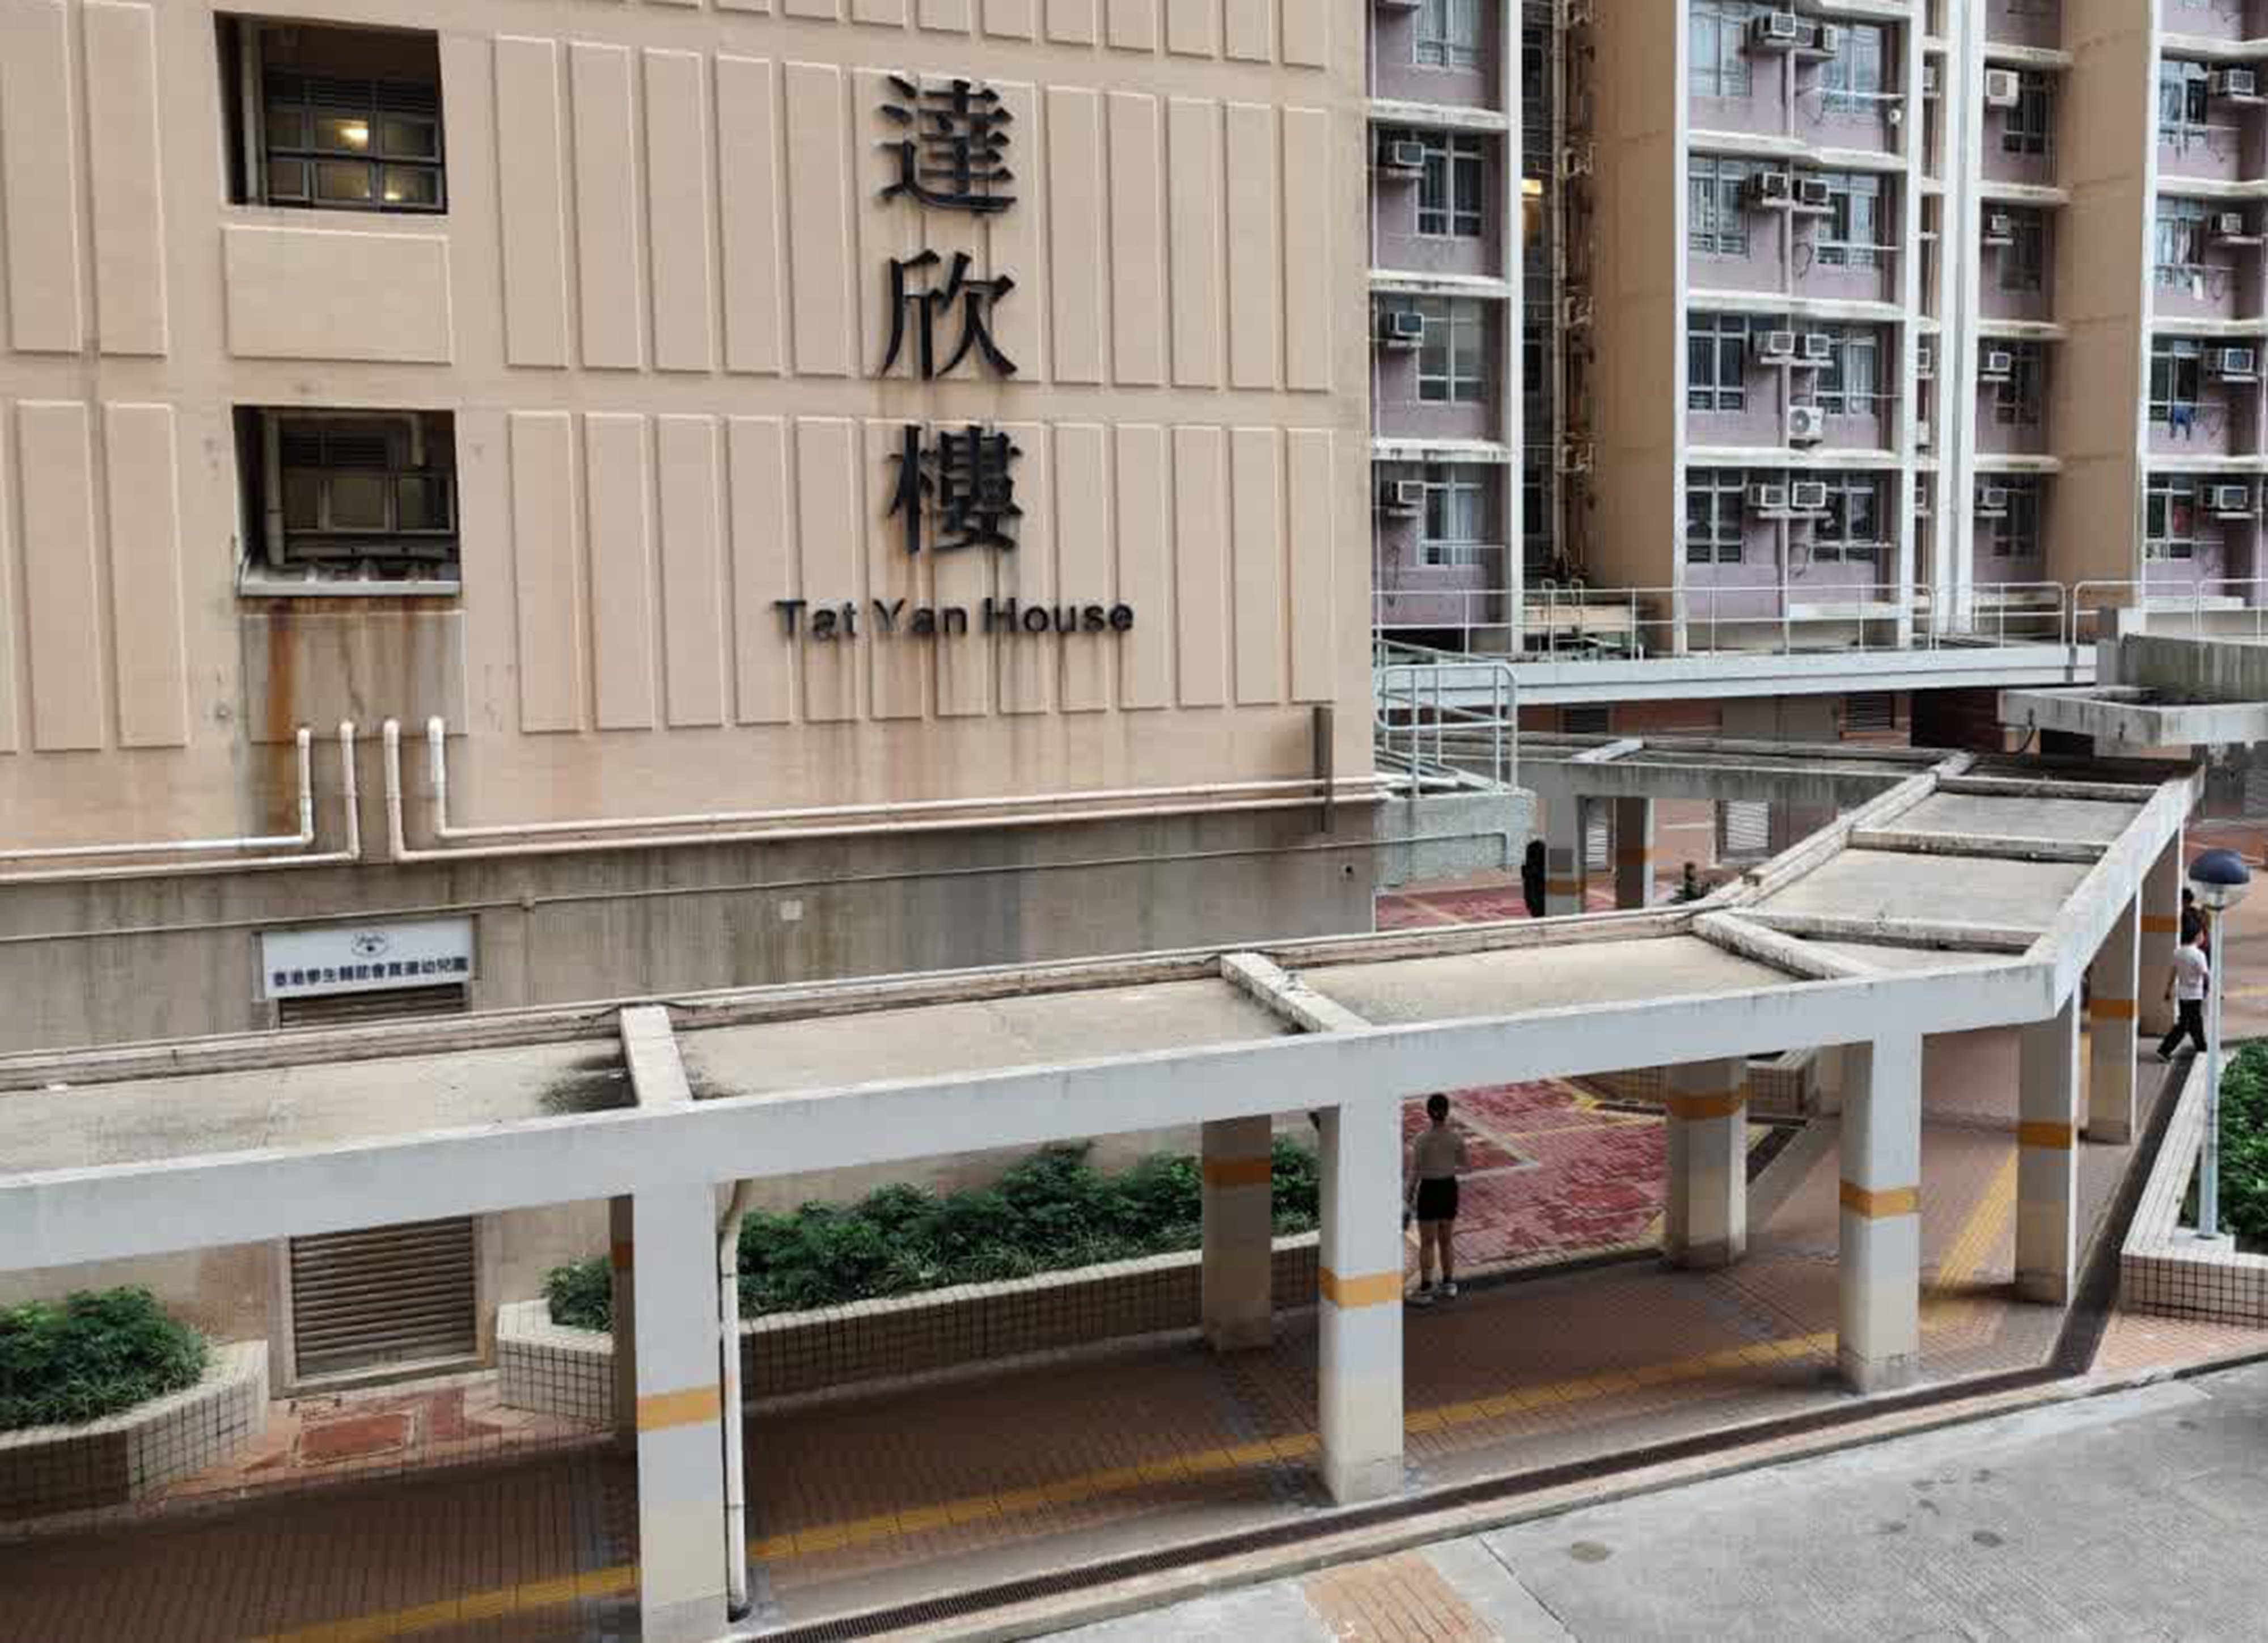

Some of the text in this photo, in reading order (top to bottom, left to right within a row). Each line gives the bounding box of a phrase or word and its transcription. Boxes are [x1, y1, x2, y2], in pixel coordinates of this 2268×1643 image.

[874, 74, 1023, 555] 達欣樓
[775, 597, 1134, 637] Tat Yan House
